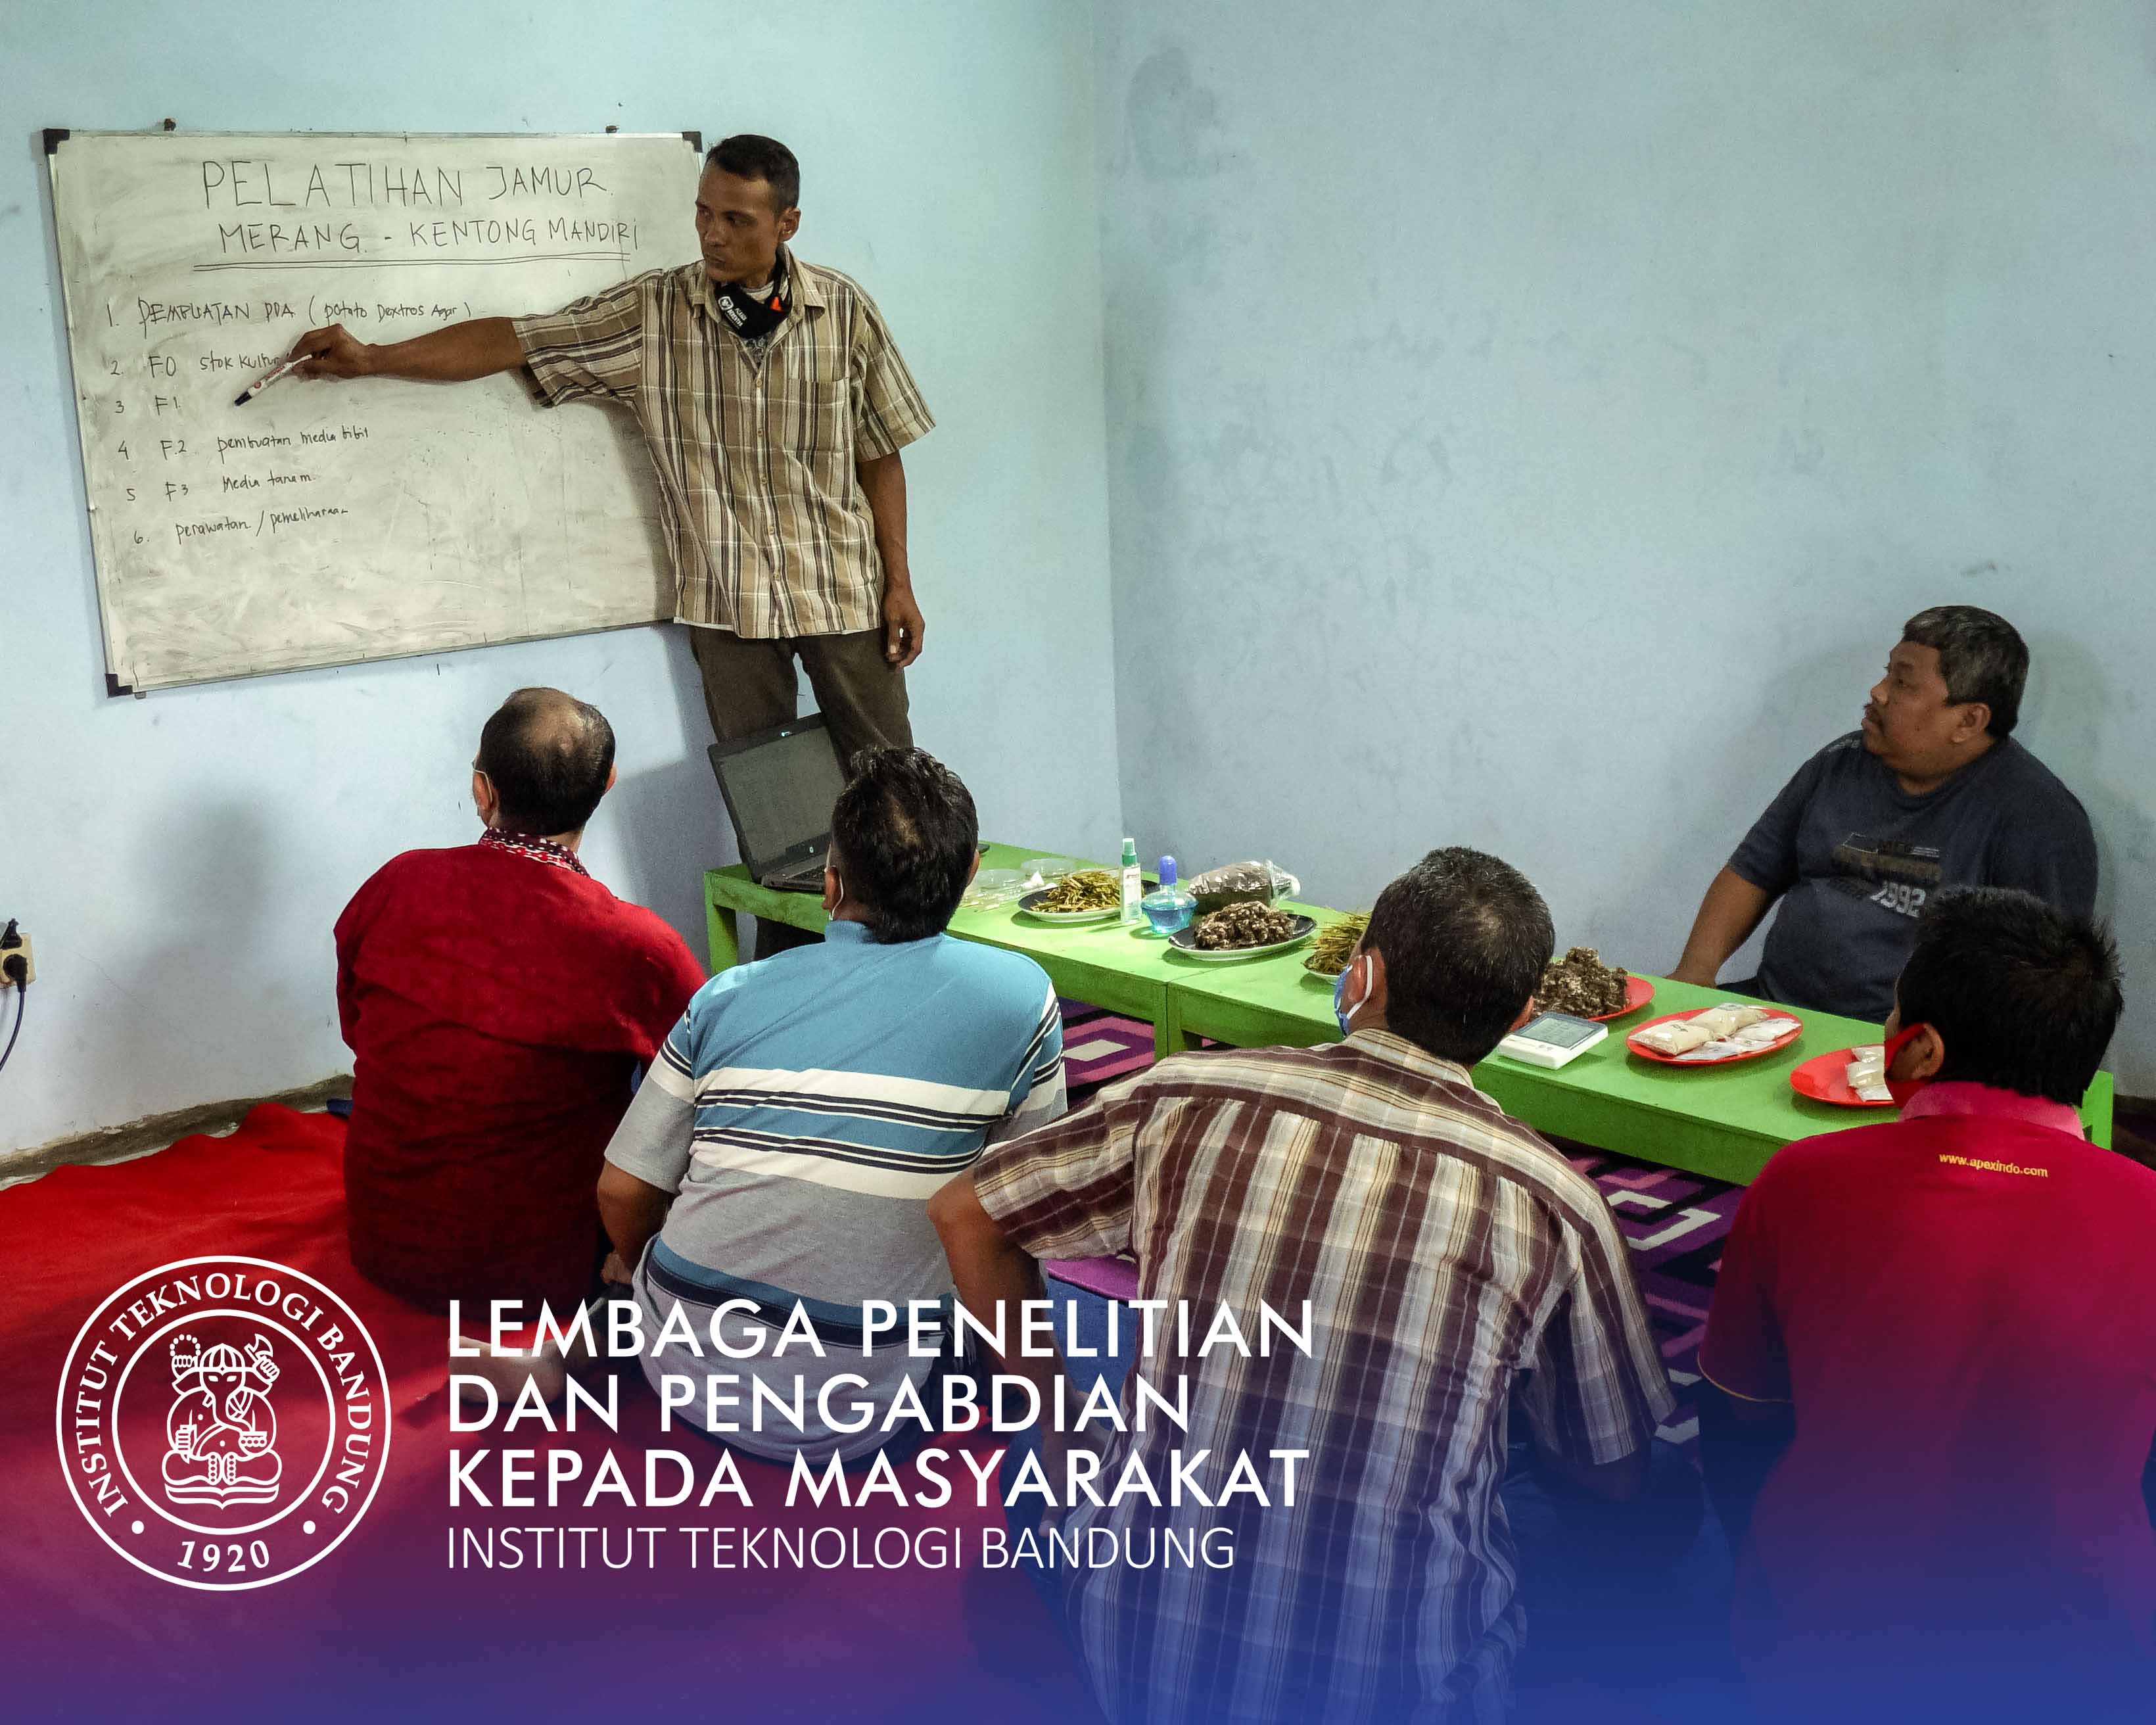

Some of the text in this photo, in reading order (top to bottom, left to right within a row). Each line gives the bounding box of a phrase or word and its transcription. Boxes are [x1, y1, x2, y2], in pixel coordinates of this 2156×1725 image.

[202, 161, 463, 209] PELATIHAN
[410, 218, 536, 247] KENTONG
[115, 400, 125, 414] 3
[118, 440, 129, 460] 4
[218, 436, 292, 464] pembuatan
[300, 426, 337, 445] media
[341, 425, 369, 439] bibit
[176, 517, 250, 545] perawatan
[1938, 1153, 2049, 1178] www.apexindo.com
